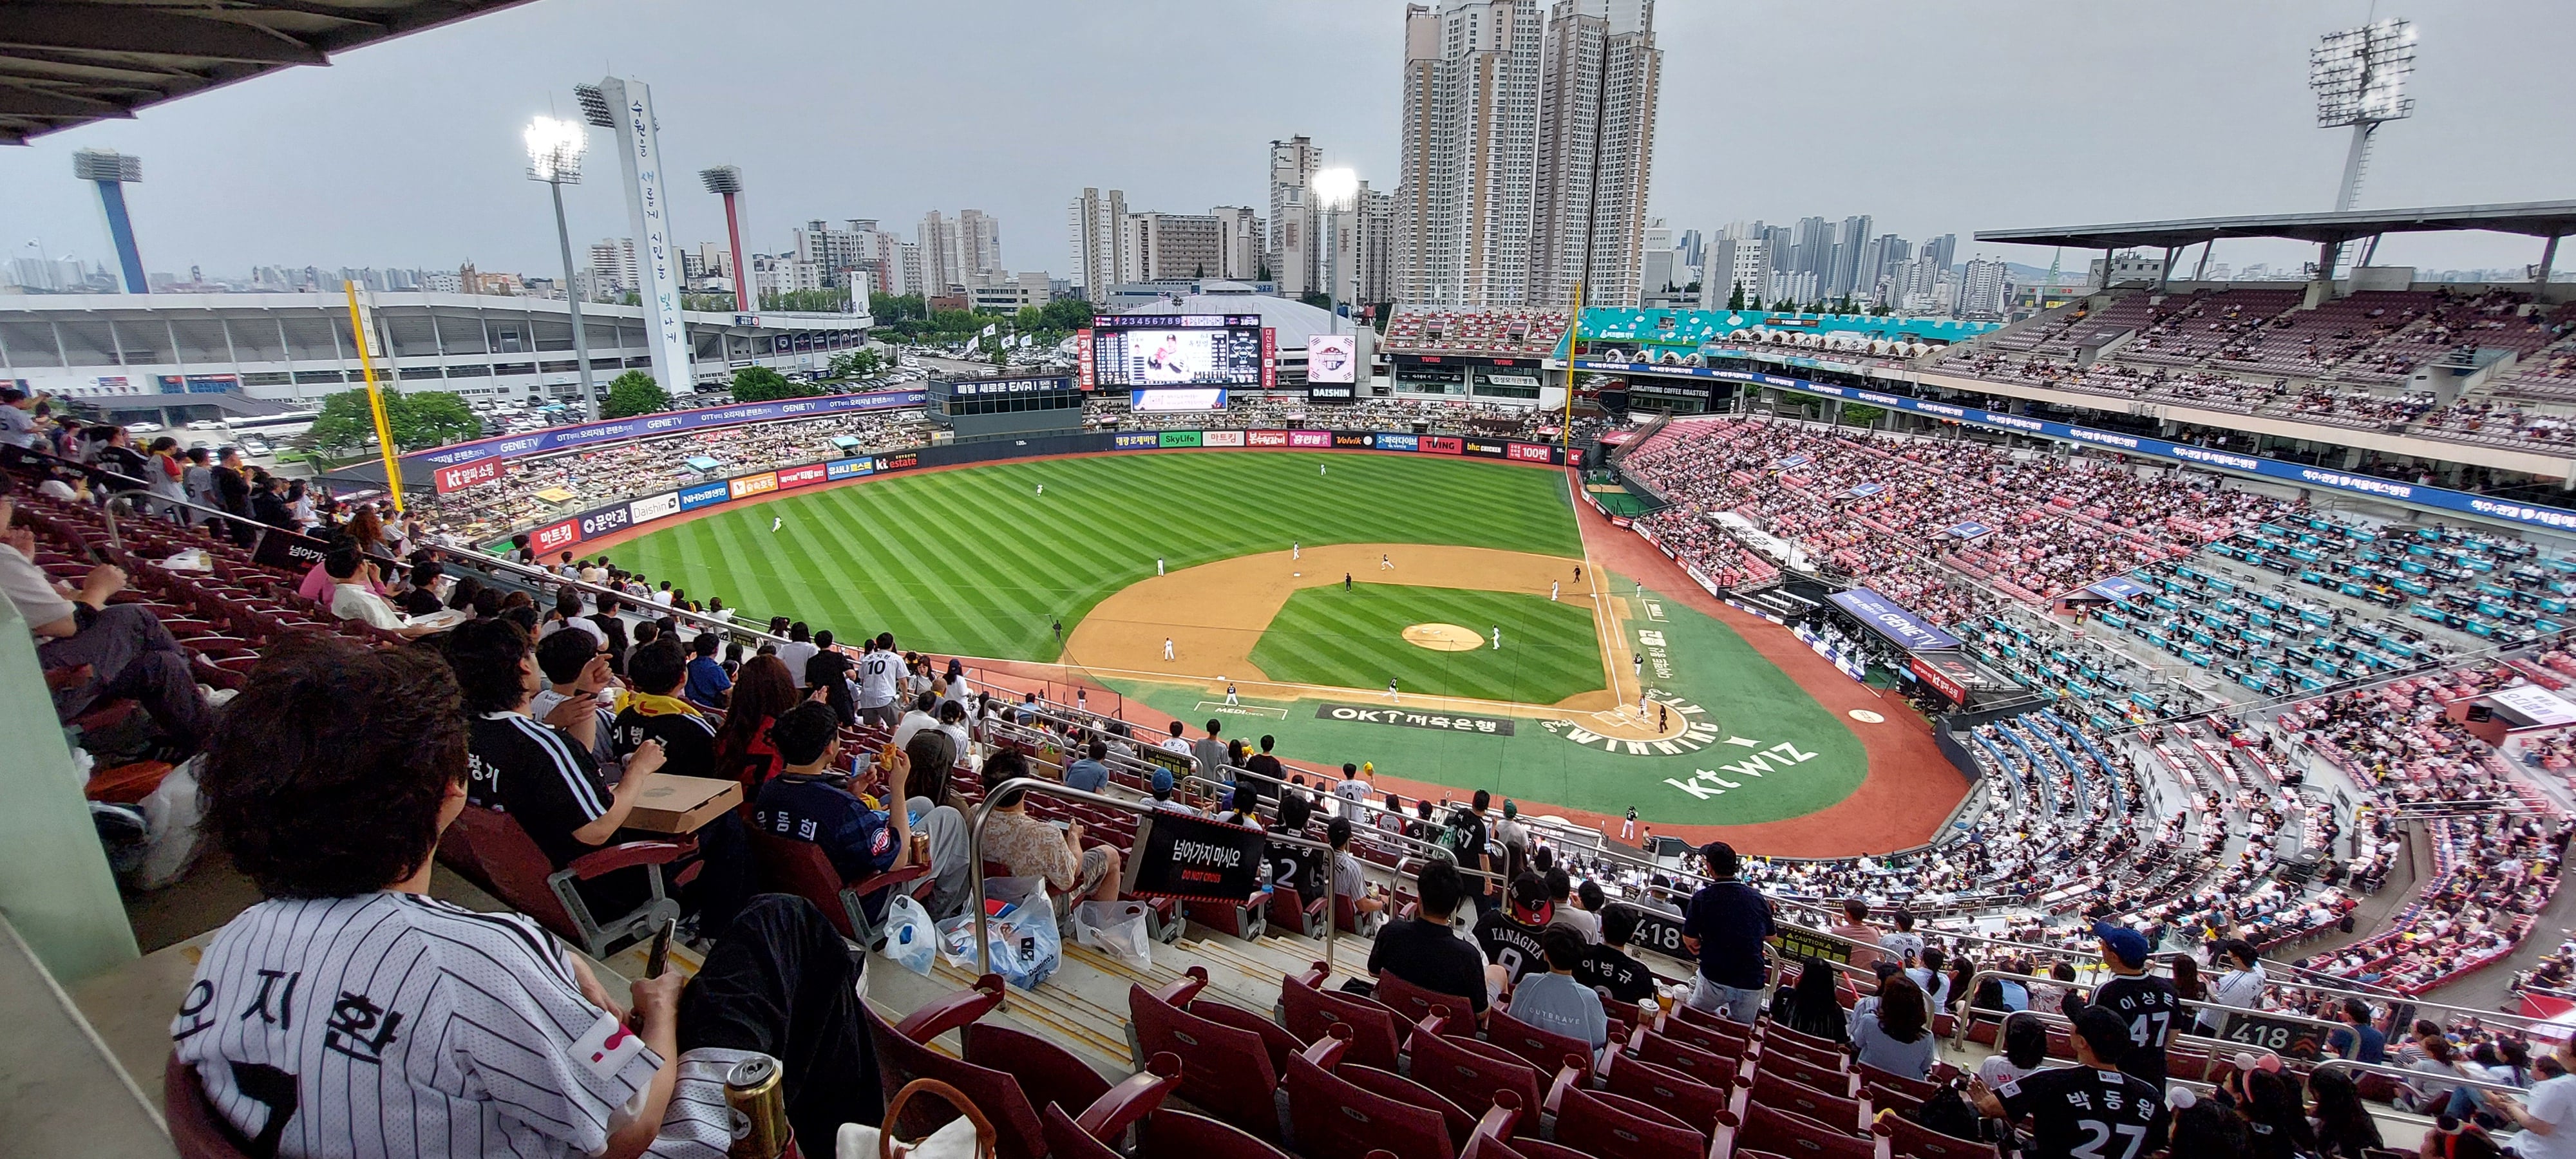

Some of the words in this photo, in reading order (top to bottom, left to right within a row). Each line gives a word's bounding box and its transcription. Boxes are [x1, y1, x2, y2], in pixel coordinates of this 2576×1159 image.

[631, 100, 647, 157] 수원을
[640, 170, 659, 220] 새롭게
[650, 231, 665, 280] 시민을
[659, 293, 677, 344] 빛나게
[958, 384, 976, 394] 매일
[980, 382, 1007, 393] 새로운
[1313, 389, 1350, 397] DAISHIN
[782, 404, 804, 413] GENIE
[805, 402, 816, 411] TV
[849, 398, 871, 406] 오리지널
[723, 410, 746, 419] 오리지널
[647, 419, 671, 429] GENIE
[671, 417, 683, 426] TV
[580, 428, 605, 438] 오리지널
[1166, 435, 1195, 444] SkyLife
[1211, 433, 1236, 444] 마트킹
[1336, 435, 1362, 445] Volvik
[500, 440, 527, 452] GENIE
[527, 438, 539, 449] TV
[1426, 439, 1455, 449] TVING
[1467, 442, 1480, 451] bhc
[1522, 446, 1548, 460] 100번
[876, 458, 889, 471] kt
[889, 457, 917, 468] estate
[446, 471, 462, 488] kt
[461, 468, 478, 484] 알파
[479, 462, 494, 480] 쇼핑
[634, 501, 667, 518] Daishin
[595, 509, 628, 530] 문안과
[540, 523, 573, 544] 마트킹
[1878, 613, 1924, 637] GENIE
[867, 661, 886, 675] 10
[1932, 674, 1940, 687] kt
[1215, 707, 1245, 716] MEDI
[1332, 708, 1379, 722] OK
[1406, 715, 1497, 733] 저축은행
[466, 753, 500, 793] 창기
[1172, 839, 1214, 866] 넘어가지
[1214, 847, 1241, 868] 마시오
[1181, 870, 1191, 880] DO
[1191, 871, 1204, 881] NOT
[1204, 872, 1221, 883] CROSS
[1276, 858, 1297, 887] 2
[1633, 919, 1680, 949] 418
[1794, 934, 1825, 947] CAUTION
[1492, 928, 1544, 960] YANAGITA
[1027, 953, 1055, 977] Domino's
[1582, 959, 1632, 984] 이병규
[173, 967, 397, 1068] 오지환
[1529, 1007, 1580, 1025] OUTBRAVE
[2129, 1011, 2170, 1047] 47
[2231, 1022, 2289, 1049] 418
[2066, 1090, 2155, 1121] 박동원
[2070, 1119, 2147, 1159] 27
